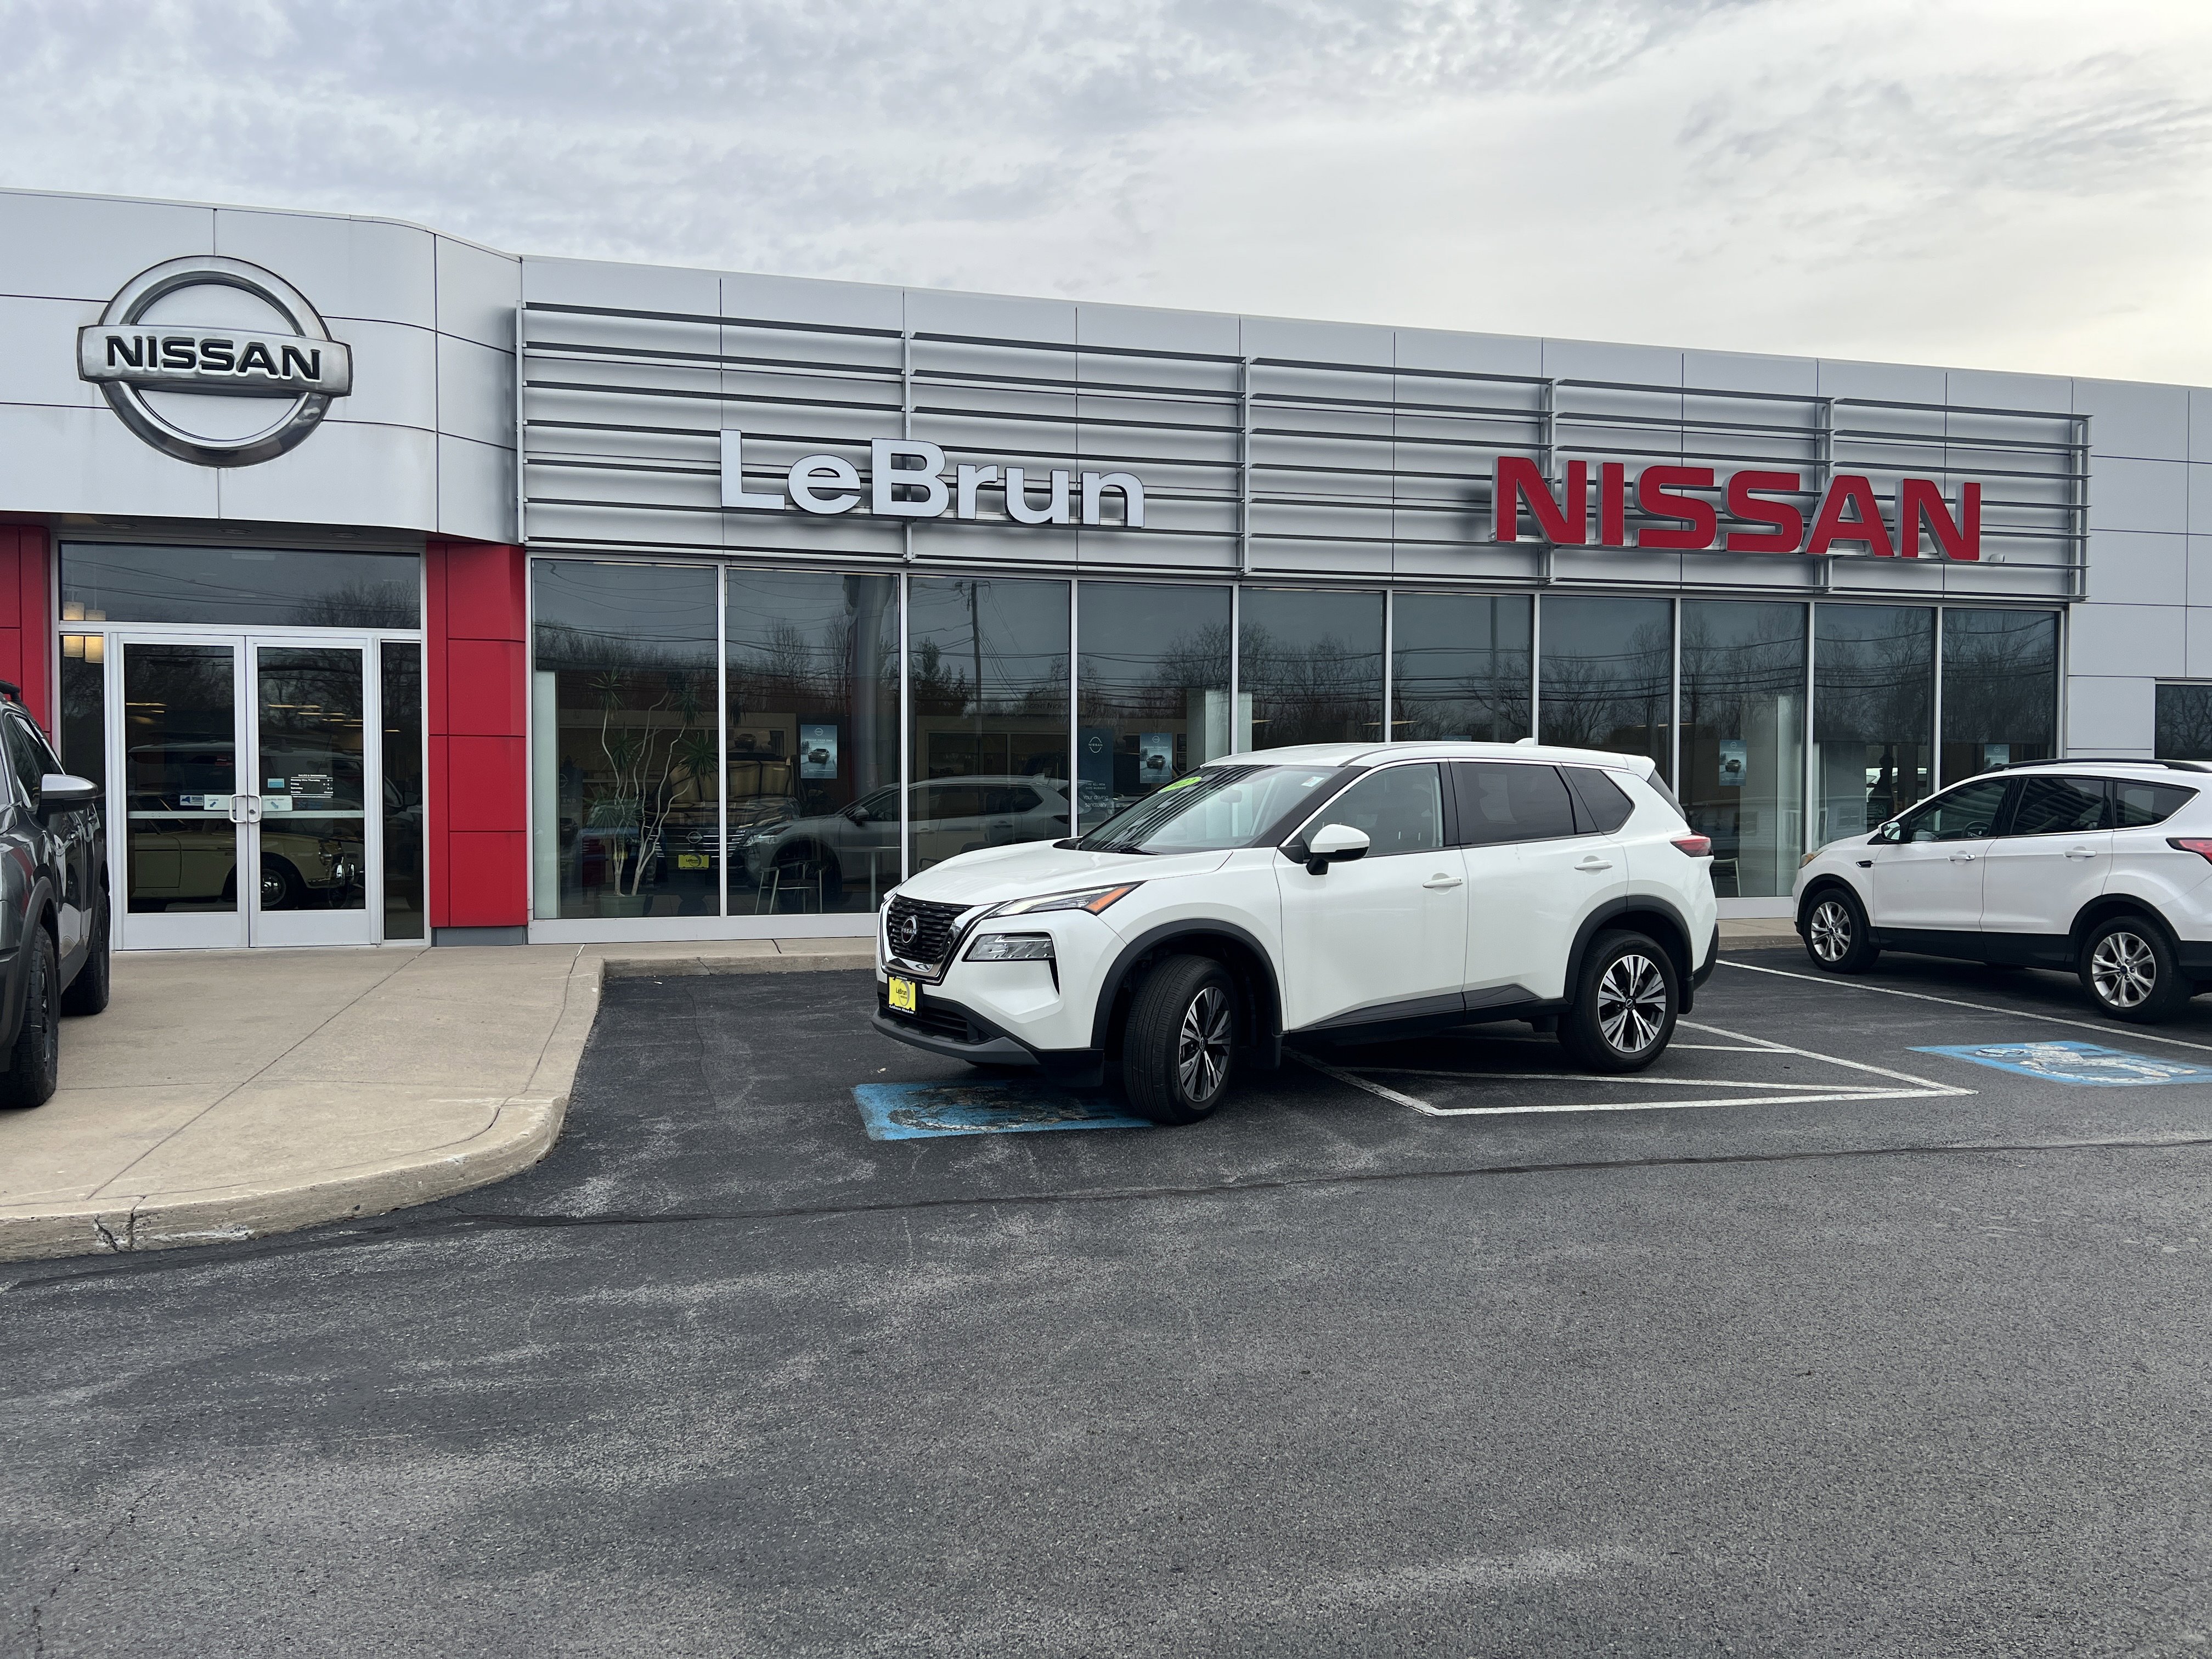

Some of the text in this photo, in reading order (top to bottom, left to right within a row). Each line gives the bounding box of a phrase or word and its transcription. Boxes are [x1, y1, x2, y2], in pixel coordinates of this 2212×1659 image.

[106, 336, 321, 380] NISSAN
[720, 429, 1145, 528] LeBrun
[1491, 456, 1981, 561] NISSAN
[895, 987, 907, 996] LeBrun
